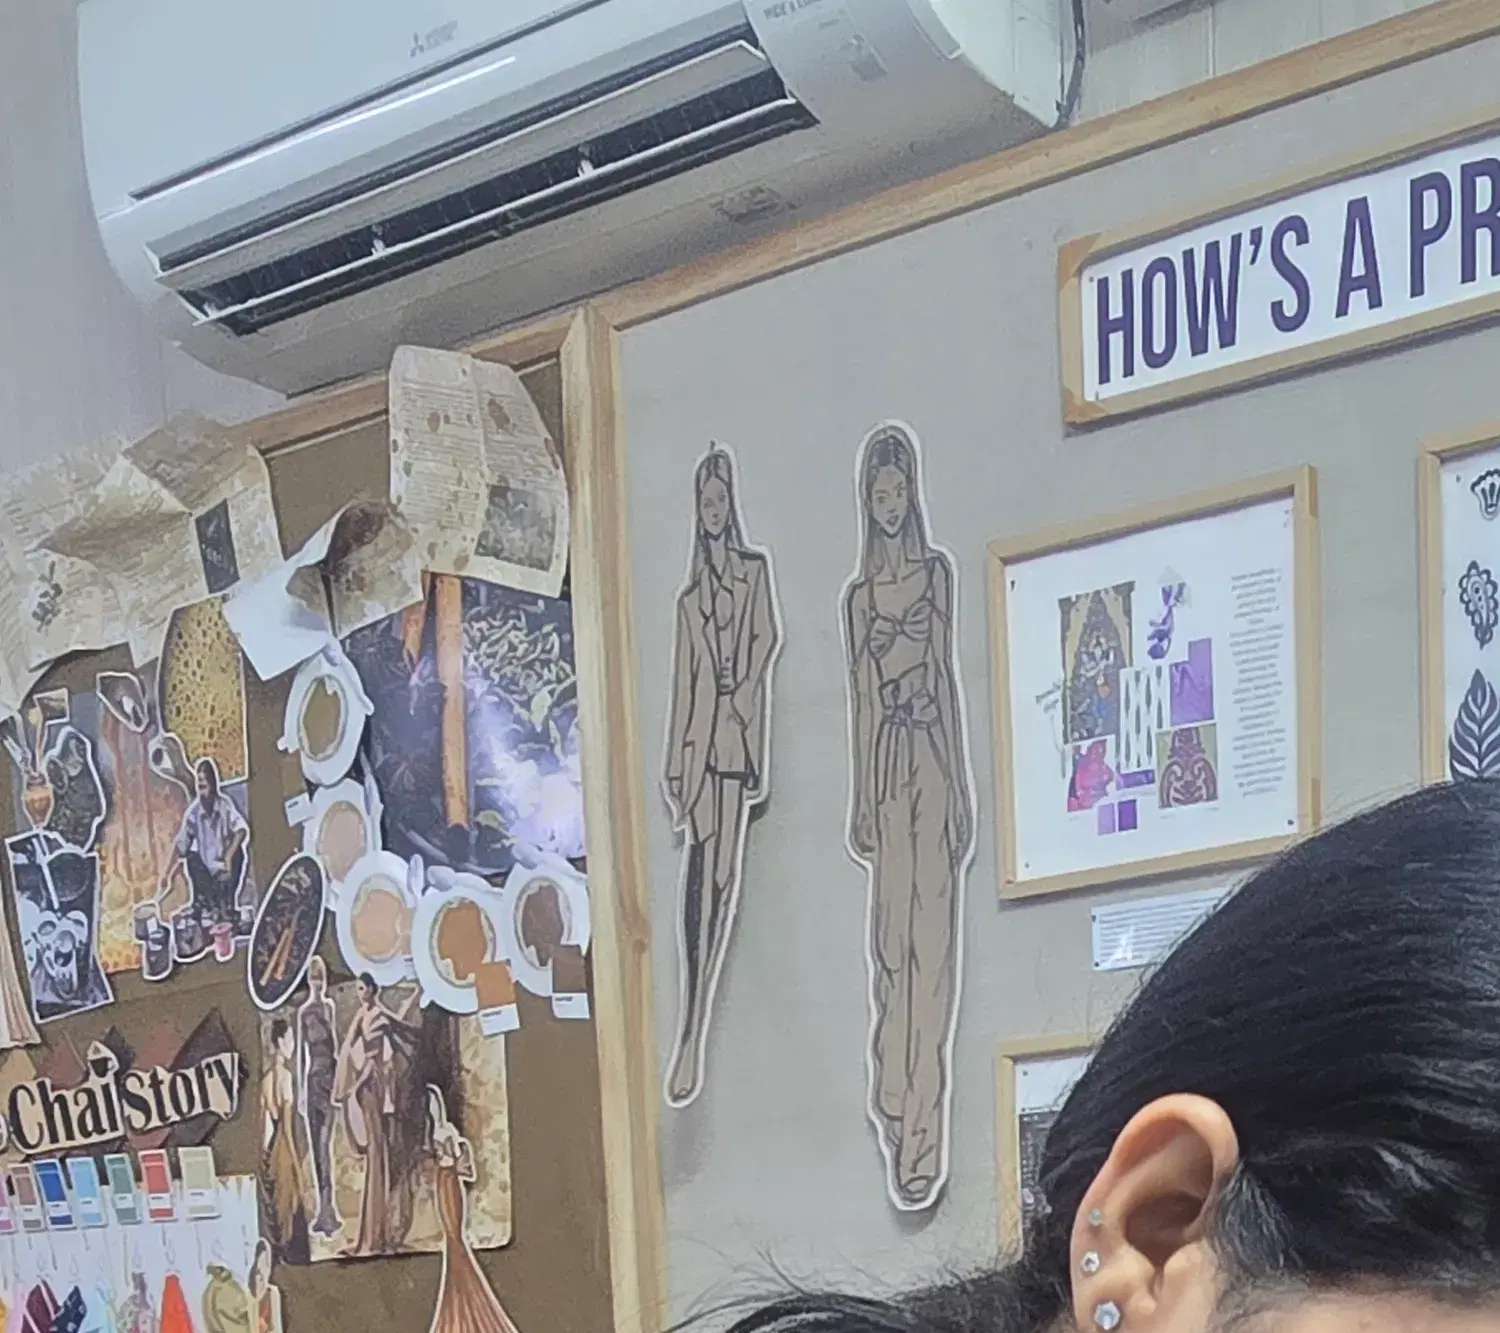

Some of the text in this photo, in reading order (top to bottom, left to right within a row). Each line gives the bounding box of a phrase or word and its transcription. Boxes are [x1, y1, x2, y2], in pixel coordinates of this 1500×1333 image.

[1097, 215, 1310, 385] HOW'S
[1334, 196, 1383, 318] A
[8, 1056, 238, 1149] Chai Story
